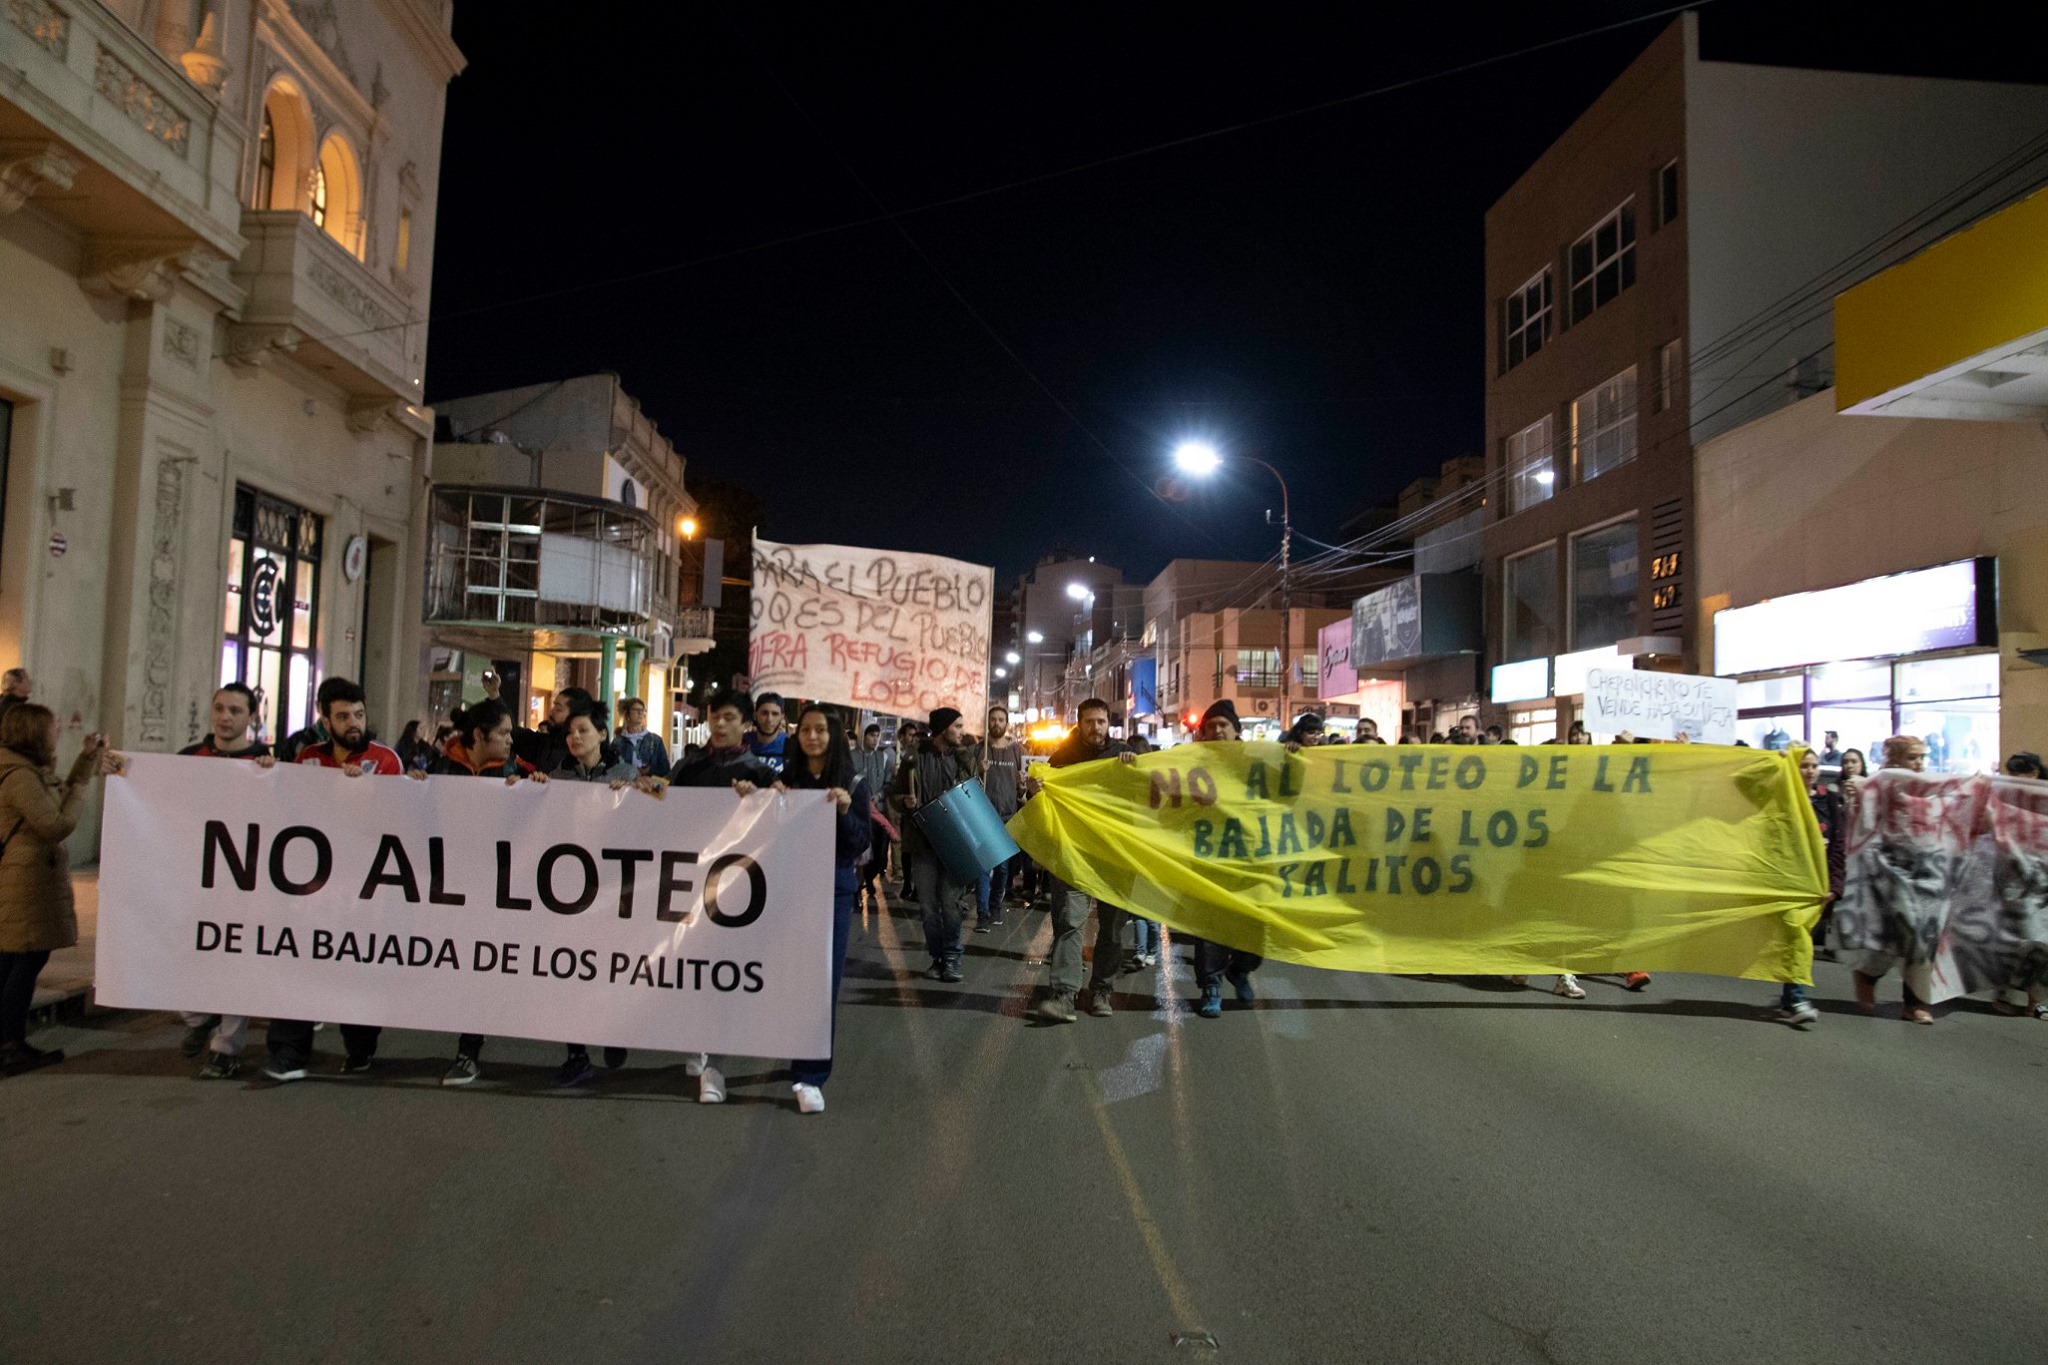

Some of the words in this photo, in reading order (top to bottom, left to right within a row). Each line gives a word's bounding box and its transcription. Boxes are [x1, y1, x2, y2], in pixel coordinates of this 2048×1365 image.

[866, 556, 986, 613] PUEBLO
[856, 600, 909, 643] DEL
[823, 631, 949, 681] REFUGIO
[1150, 766, 1218, 810] NO
[1246, 761, 1300, 799] AL
[1332, 754, 1487, 795] LOTEO
[1516, 754, 1569, 790] DE
[1592, 754, 1654, 794] LA
[1193, 806, 1357, 859] BAJADA
[1384, 806, 1433, 844] DE
[1458, 808, 1550, 849] LOS
[201, 819, 333, 897] NO
[358, 833, 466, 907] AL
[495, 840, 768, 929] LOTEO
[195, 920, 244, 955] DE
[255, 924, 300, 959] LA
[312, 928, 461, 971] BAJADA
[473, 940, 520, 975] DE
[532, 945, 598, 982] LOS
[609, 951, 765, 994] PALITOS
